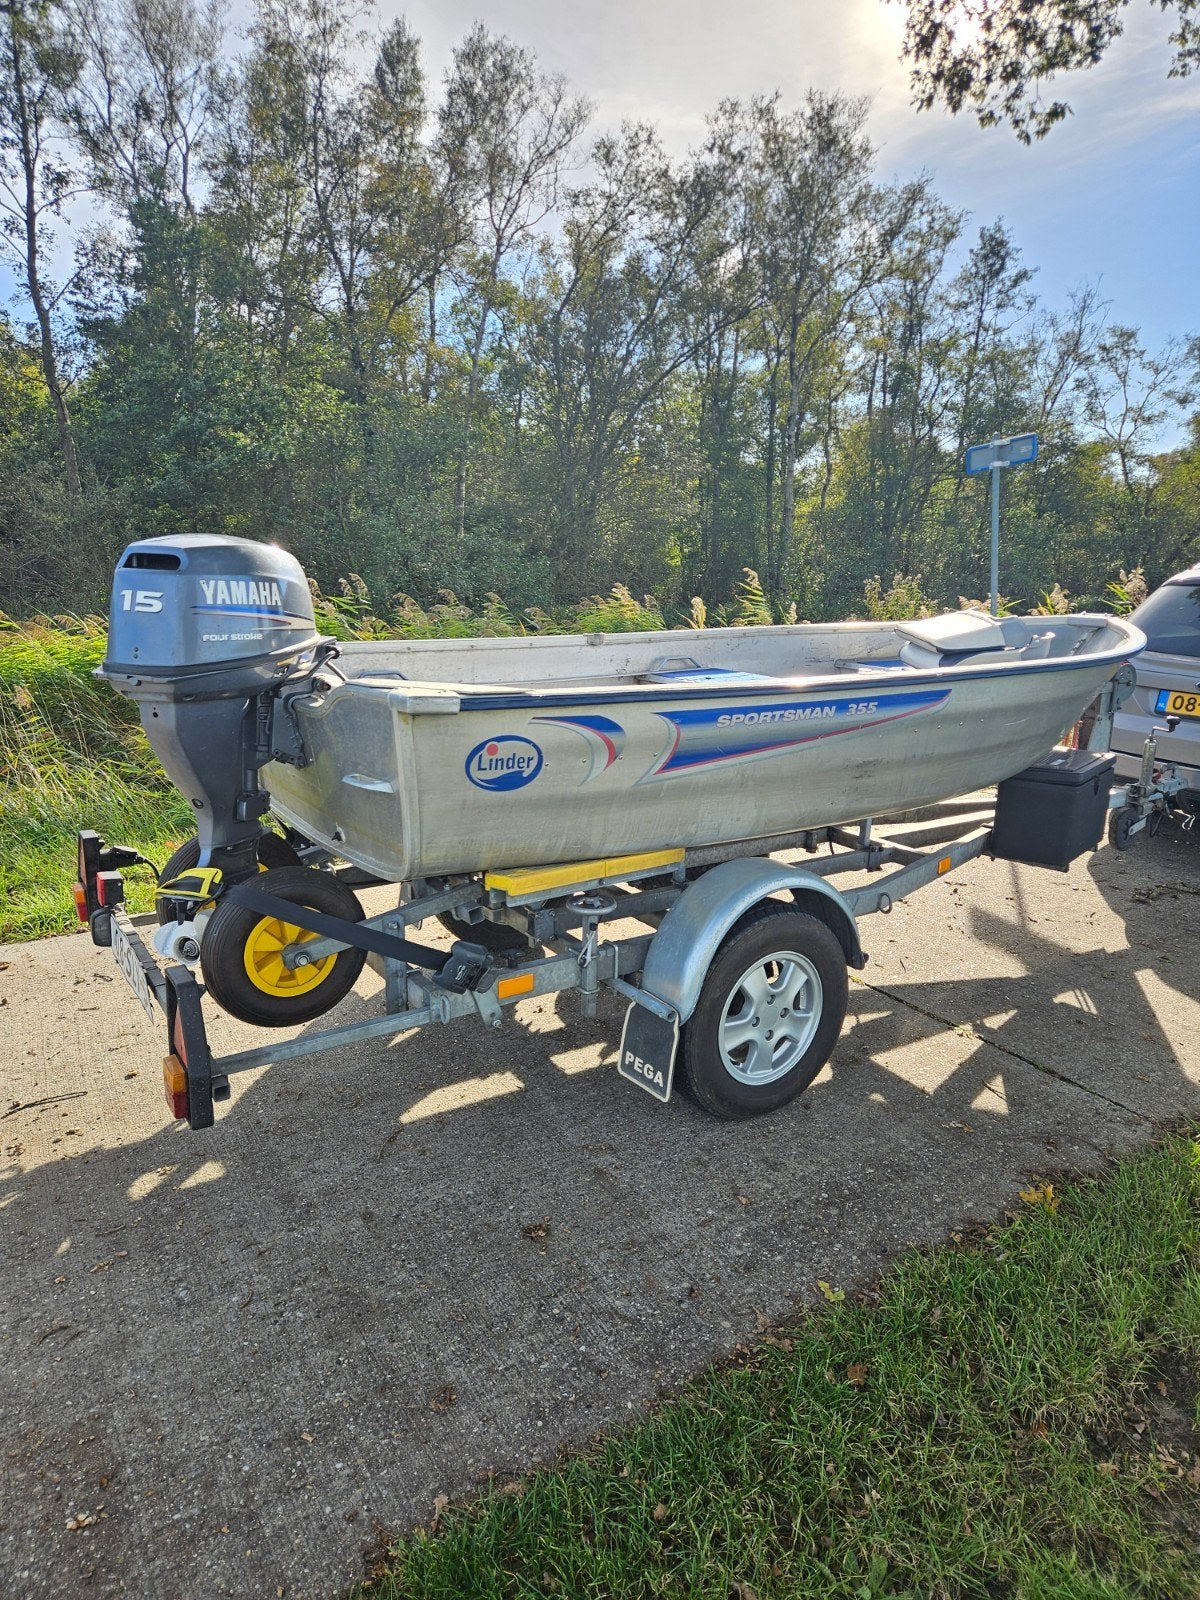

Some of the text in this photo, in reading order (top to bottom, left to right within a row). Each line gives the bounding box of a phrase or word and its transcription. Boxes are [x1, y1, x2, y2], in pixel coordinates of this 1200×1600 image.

[120, 589, 164, 613] 15
[200, 580, 282, 606] YAMAHA
[716, 702, 879, 728] SPORTSMAN 355
[477, 744, 534, 772] Linder
[625, 1050, 664, 1087] PEGA
